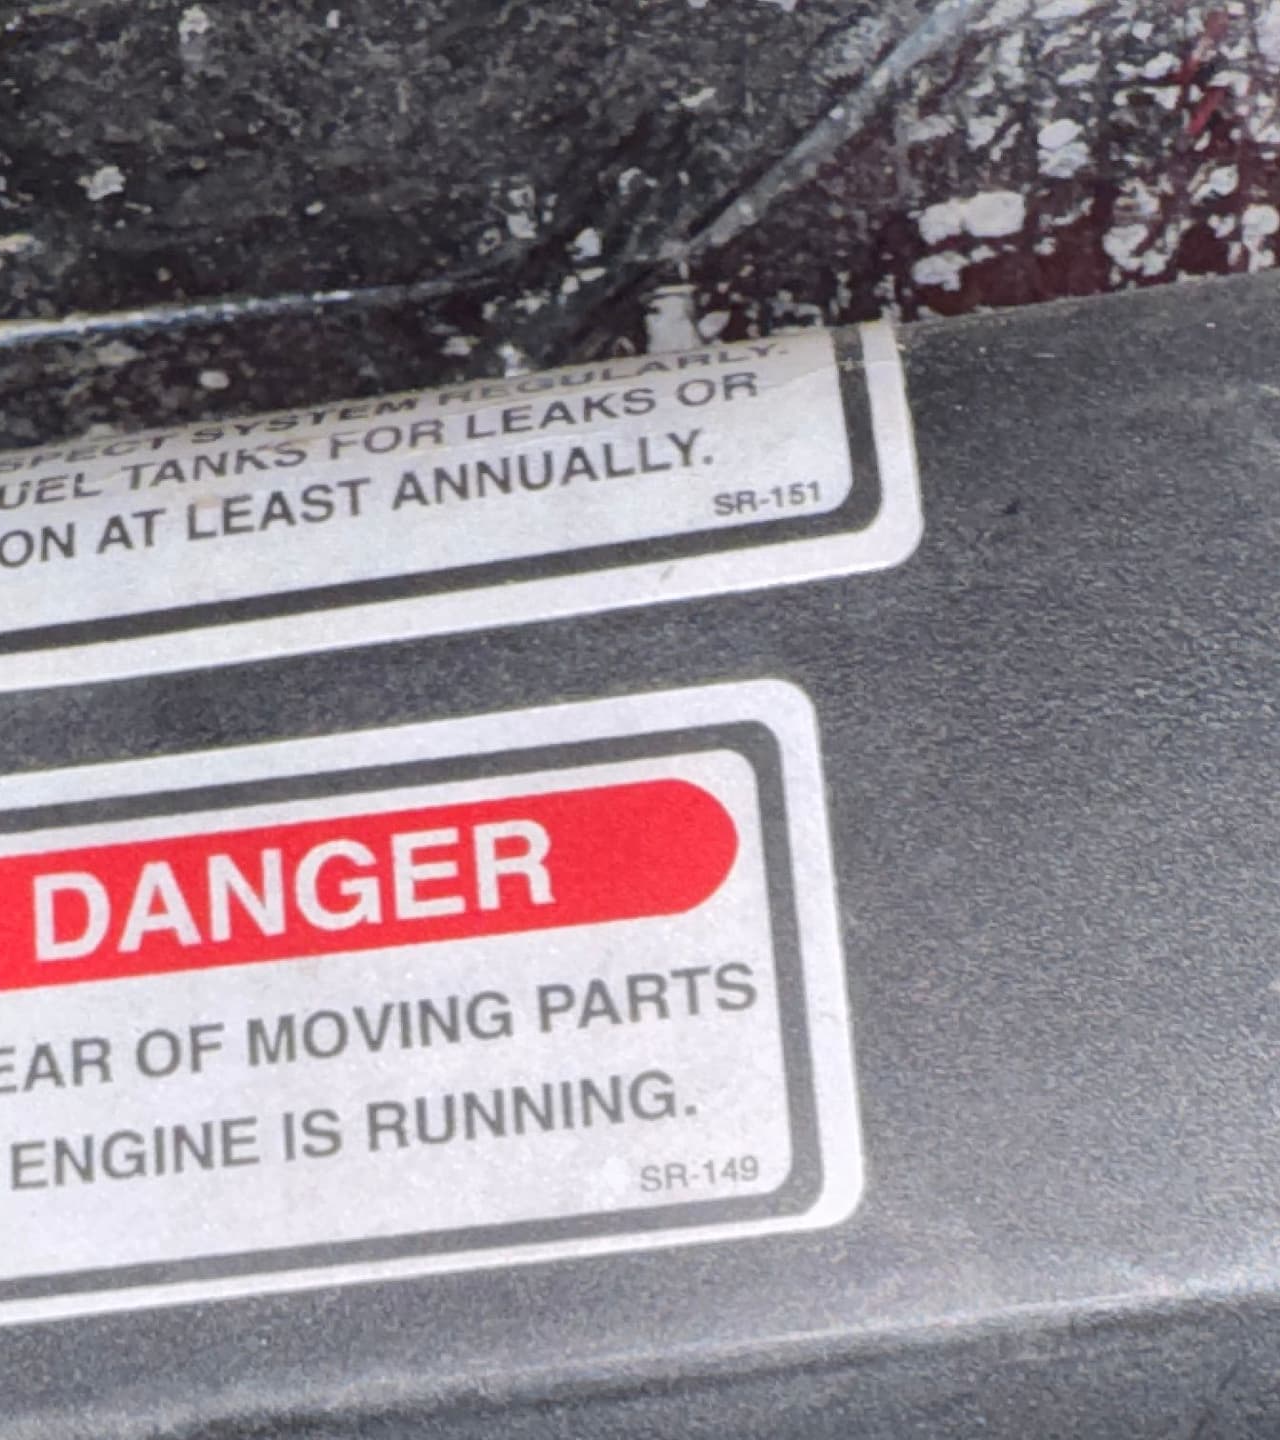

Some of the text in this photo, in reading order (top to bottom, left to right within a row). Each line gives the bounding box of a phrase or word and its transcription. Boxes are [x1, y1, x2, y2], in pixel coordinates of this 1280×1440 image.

[122, 440, 308, 490] TANKS
[329, 418, 445, 460] FOR
[466, 387, 656, 440] LEAKS
[676, 371, 758, 407] OR
[190, 397, 418, 444] SYSTEM
[437, 343, 790, 406] REGULARLY.
[96, 508, 167, 554] AT
[187, 477, 372, 541] LEAST
[391, 428, 714, 511] ANNUALLY.
[712, 479, 823, 518] SR-151
[32, 818, 556, 963] DANGER
[135, 1022, 225, 1078] OF
[246, 990, 514, 1067] MOVING
[536, 962, 758, 1033] PARTS
[9, 1115, 260, 1193] ENGINE
[282, 1109, 343, 1162] IS
[367, 1069, 698, 1152] RUNNING.
[639, 1154, 760, 1194] SR-149
